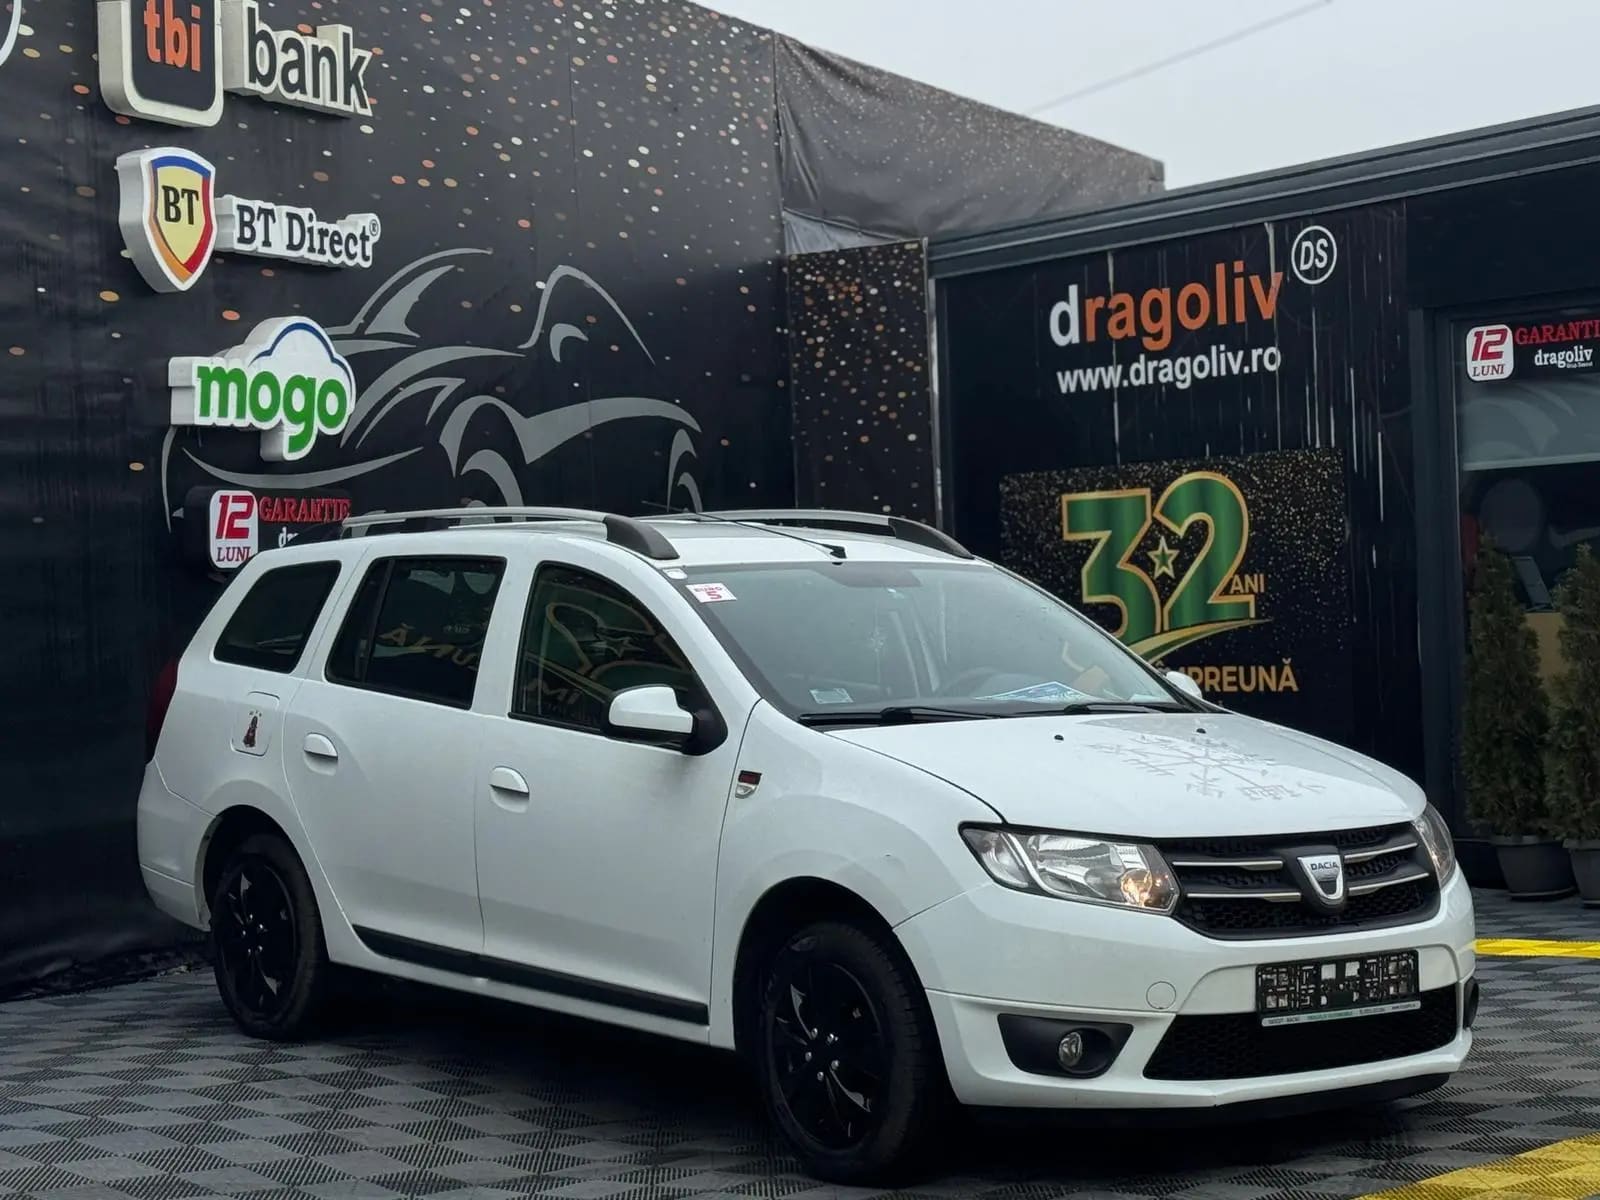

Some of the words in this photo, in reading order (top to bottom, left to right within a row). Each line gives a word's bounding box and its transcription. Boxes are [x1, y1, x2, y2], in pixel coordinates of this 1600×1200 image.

[144, 0, 200, 72] tbi
[248, 4, 368, 109] bank
[162, 185, 200, 225] BT
[237, 204, 275, 247] BT
[1299, 238, 1329, 271] DS
[1050, 260, 1283, 350] dragoliv
[1472, 328, 1508, 361] 12
[1534, 345, 1593, 368] dragoliv
[1057, 344, 1282, 393] www.dragoliv.ro
[1472, 364, 1505, 377] LUNI
[197, 365, 347, 453] mogo
[215, 495, 255, 539] 12
[259, 496, 352, 523] GARANTIE
[1061, 470, 1256, 652] 32
[706, 590, 723, 600] 5
[1230, 573, 1266, 595] ANI
[1154, 657, 1299, 693] PREUNĂ
[1310, 861, 1338, 871] DACIA
